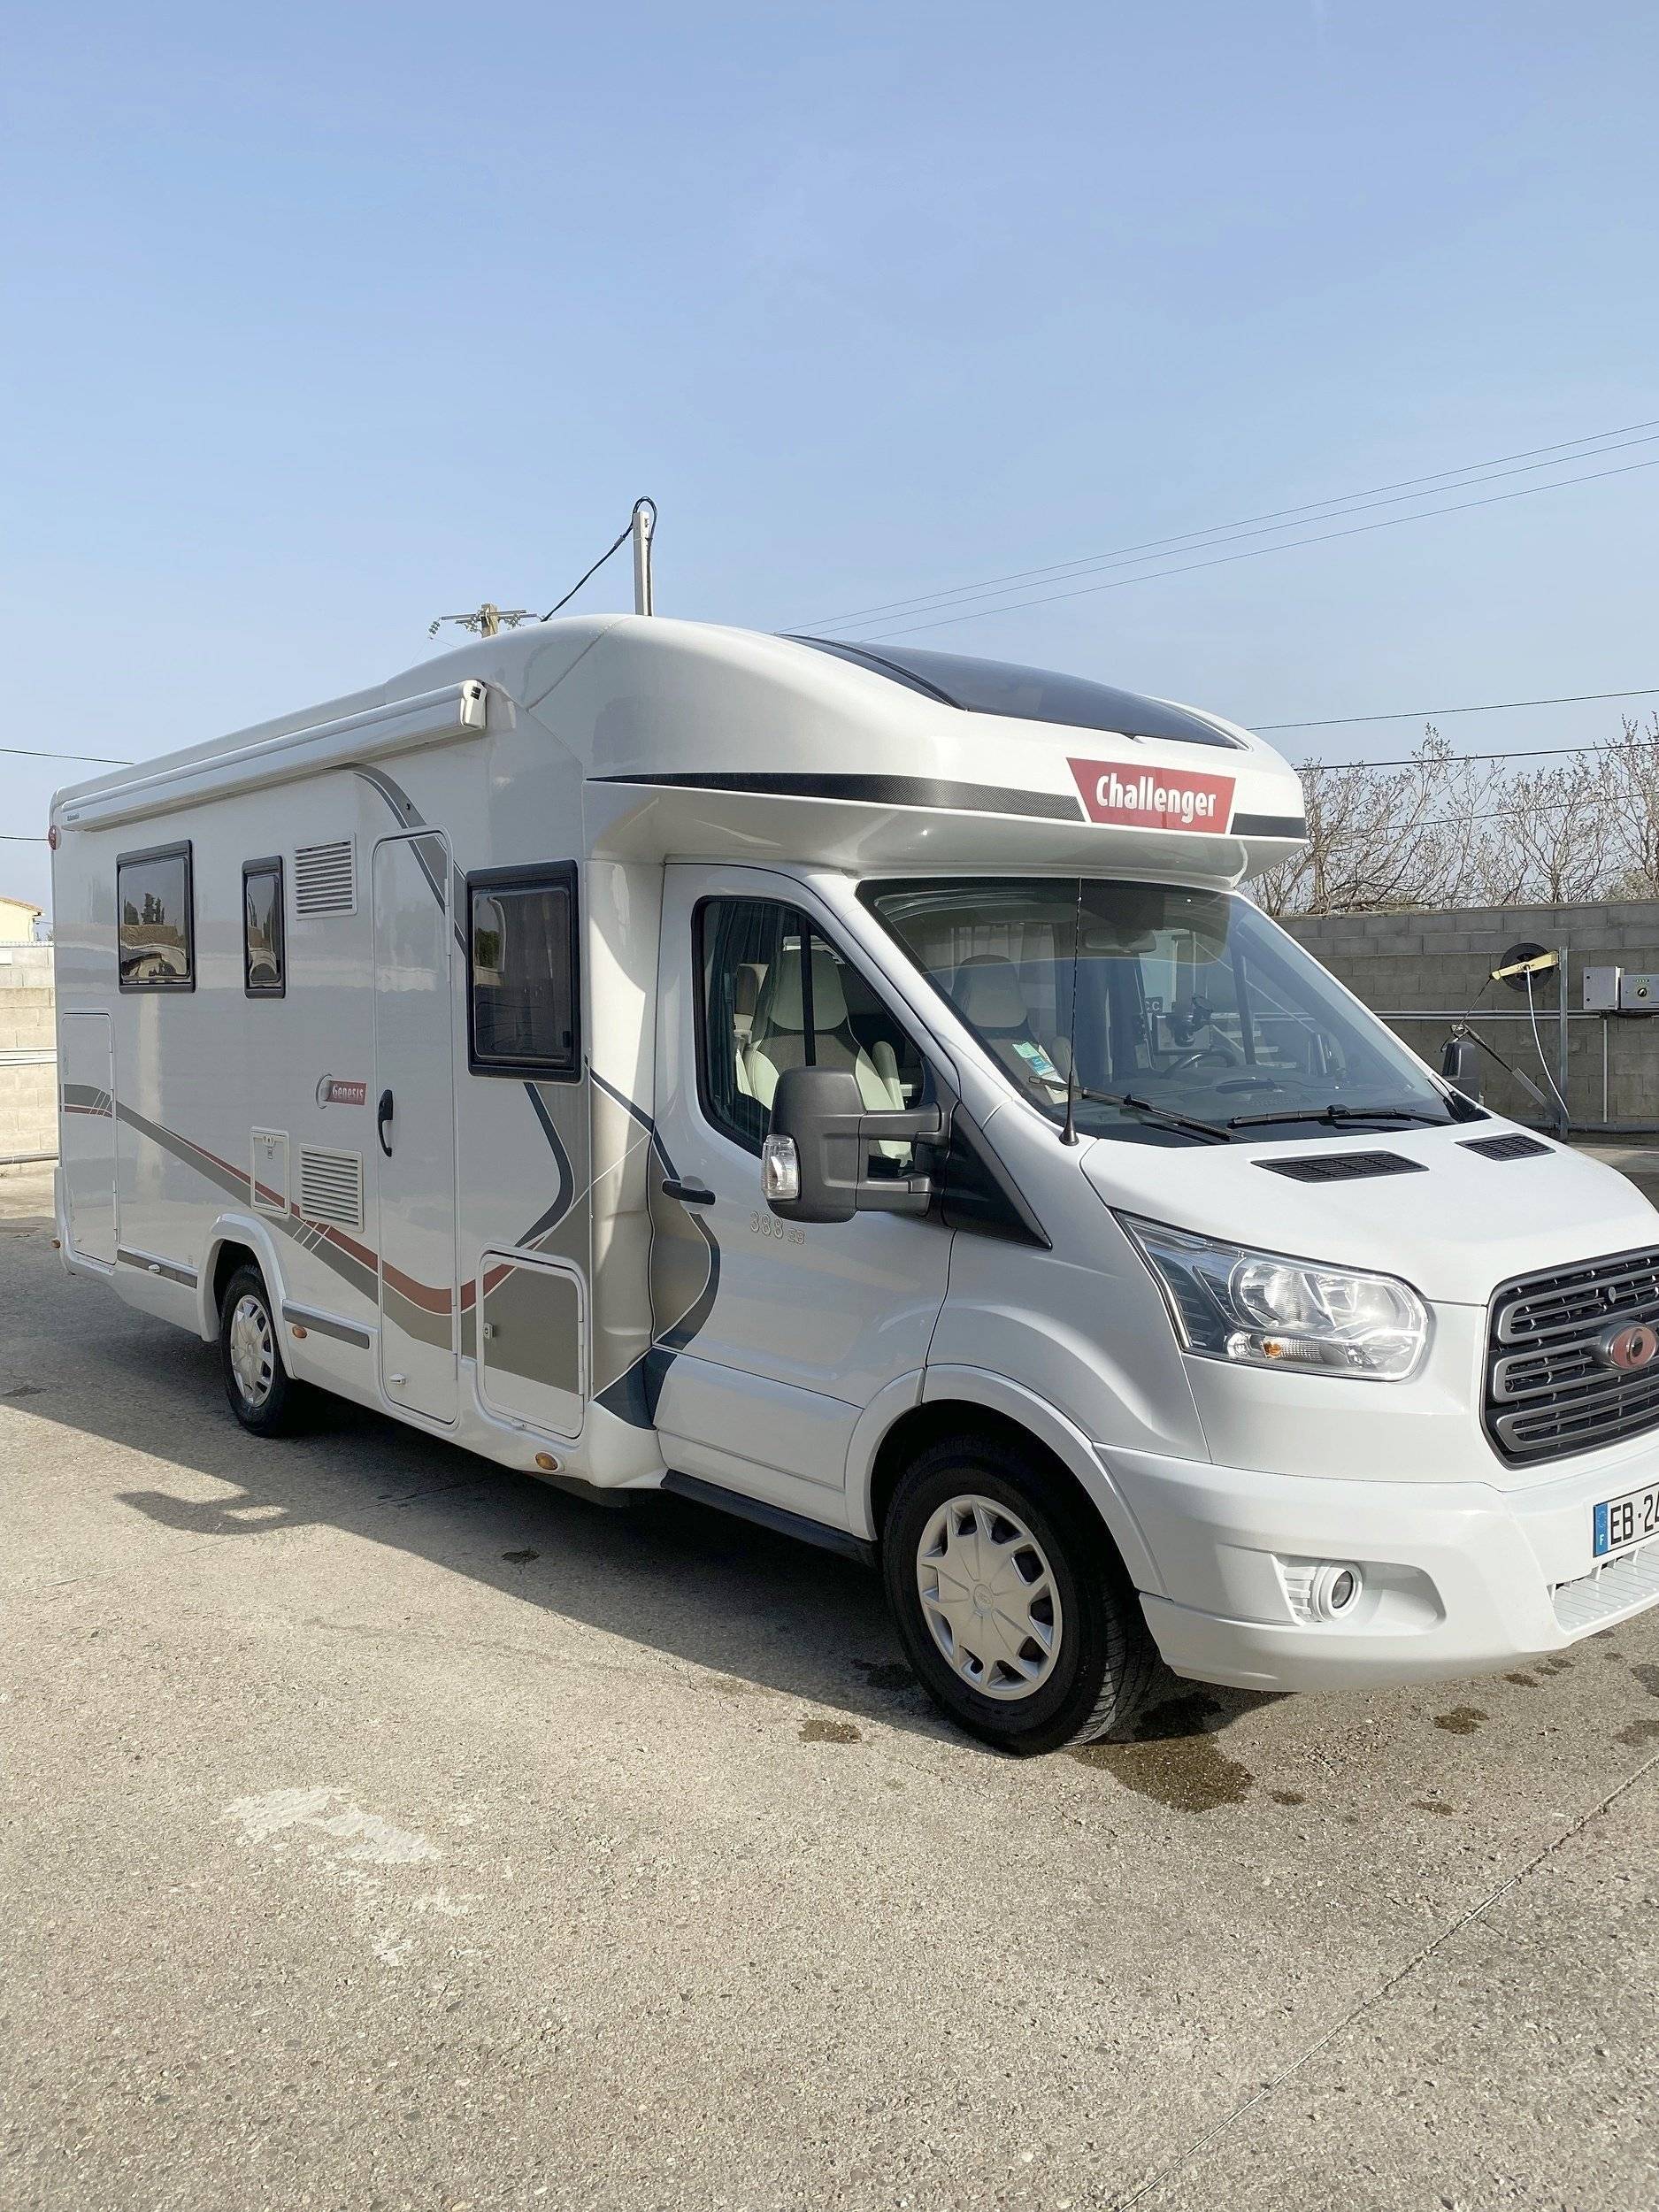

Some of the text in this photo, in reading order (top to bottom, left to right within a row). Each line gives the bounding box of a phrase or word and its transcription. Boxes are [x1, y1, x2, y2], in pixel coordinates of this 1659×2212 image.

[1095, 772, 1217, 824] Challenger
[332, 1085, 365, 1100] Genesis
[749, 1210, 784, 1240] 388
[1598, 1533, 1605, 1546] F
